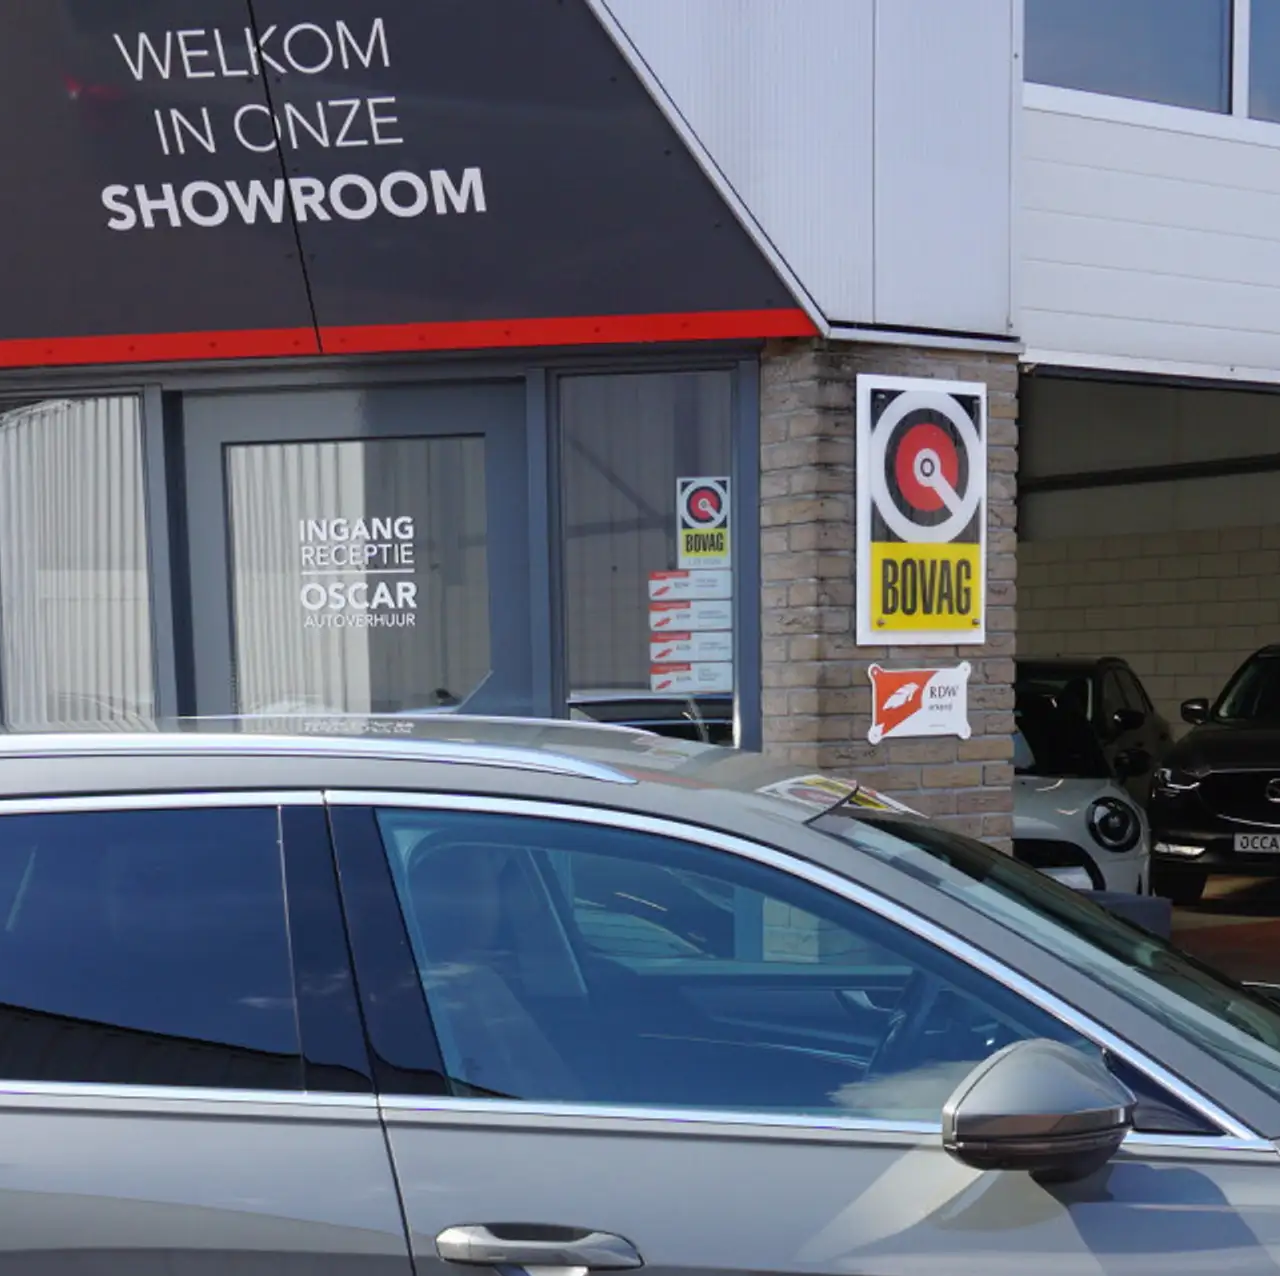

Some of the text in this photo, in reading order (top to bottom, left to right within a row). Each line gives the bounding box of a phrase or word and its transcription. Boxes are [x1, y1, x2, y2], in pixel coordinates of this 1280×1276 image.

[114, 18, 391, 81] WELKOM
[154, 97, 403, 155] IN ONZE
[101, 167, 486, 230] SHOWROOM
[300, 517, 414, 541] INGANG
[685, 533, 724, 552] BOVAG
[301, 544, 414, 566] RECEPTIE
[300, 581, 417, 611] OSCAR
[881, 558, 972, 616] BOVAG
[303, 613, 415, 628] AUTOVERHUUR
[929, 686, 959, 698] RDW
